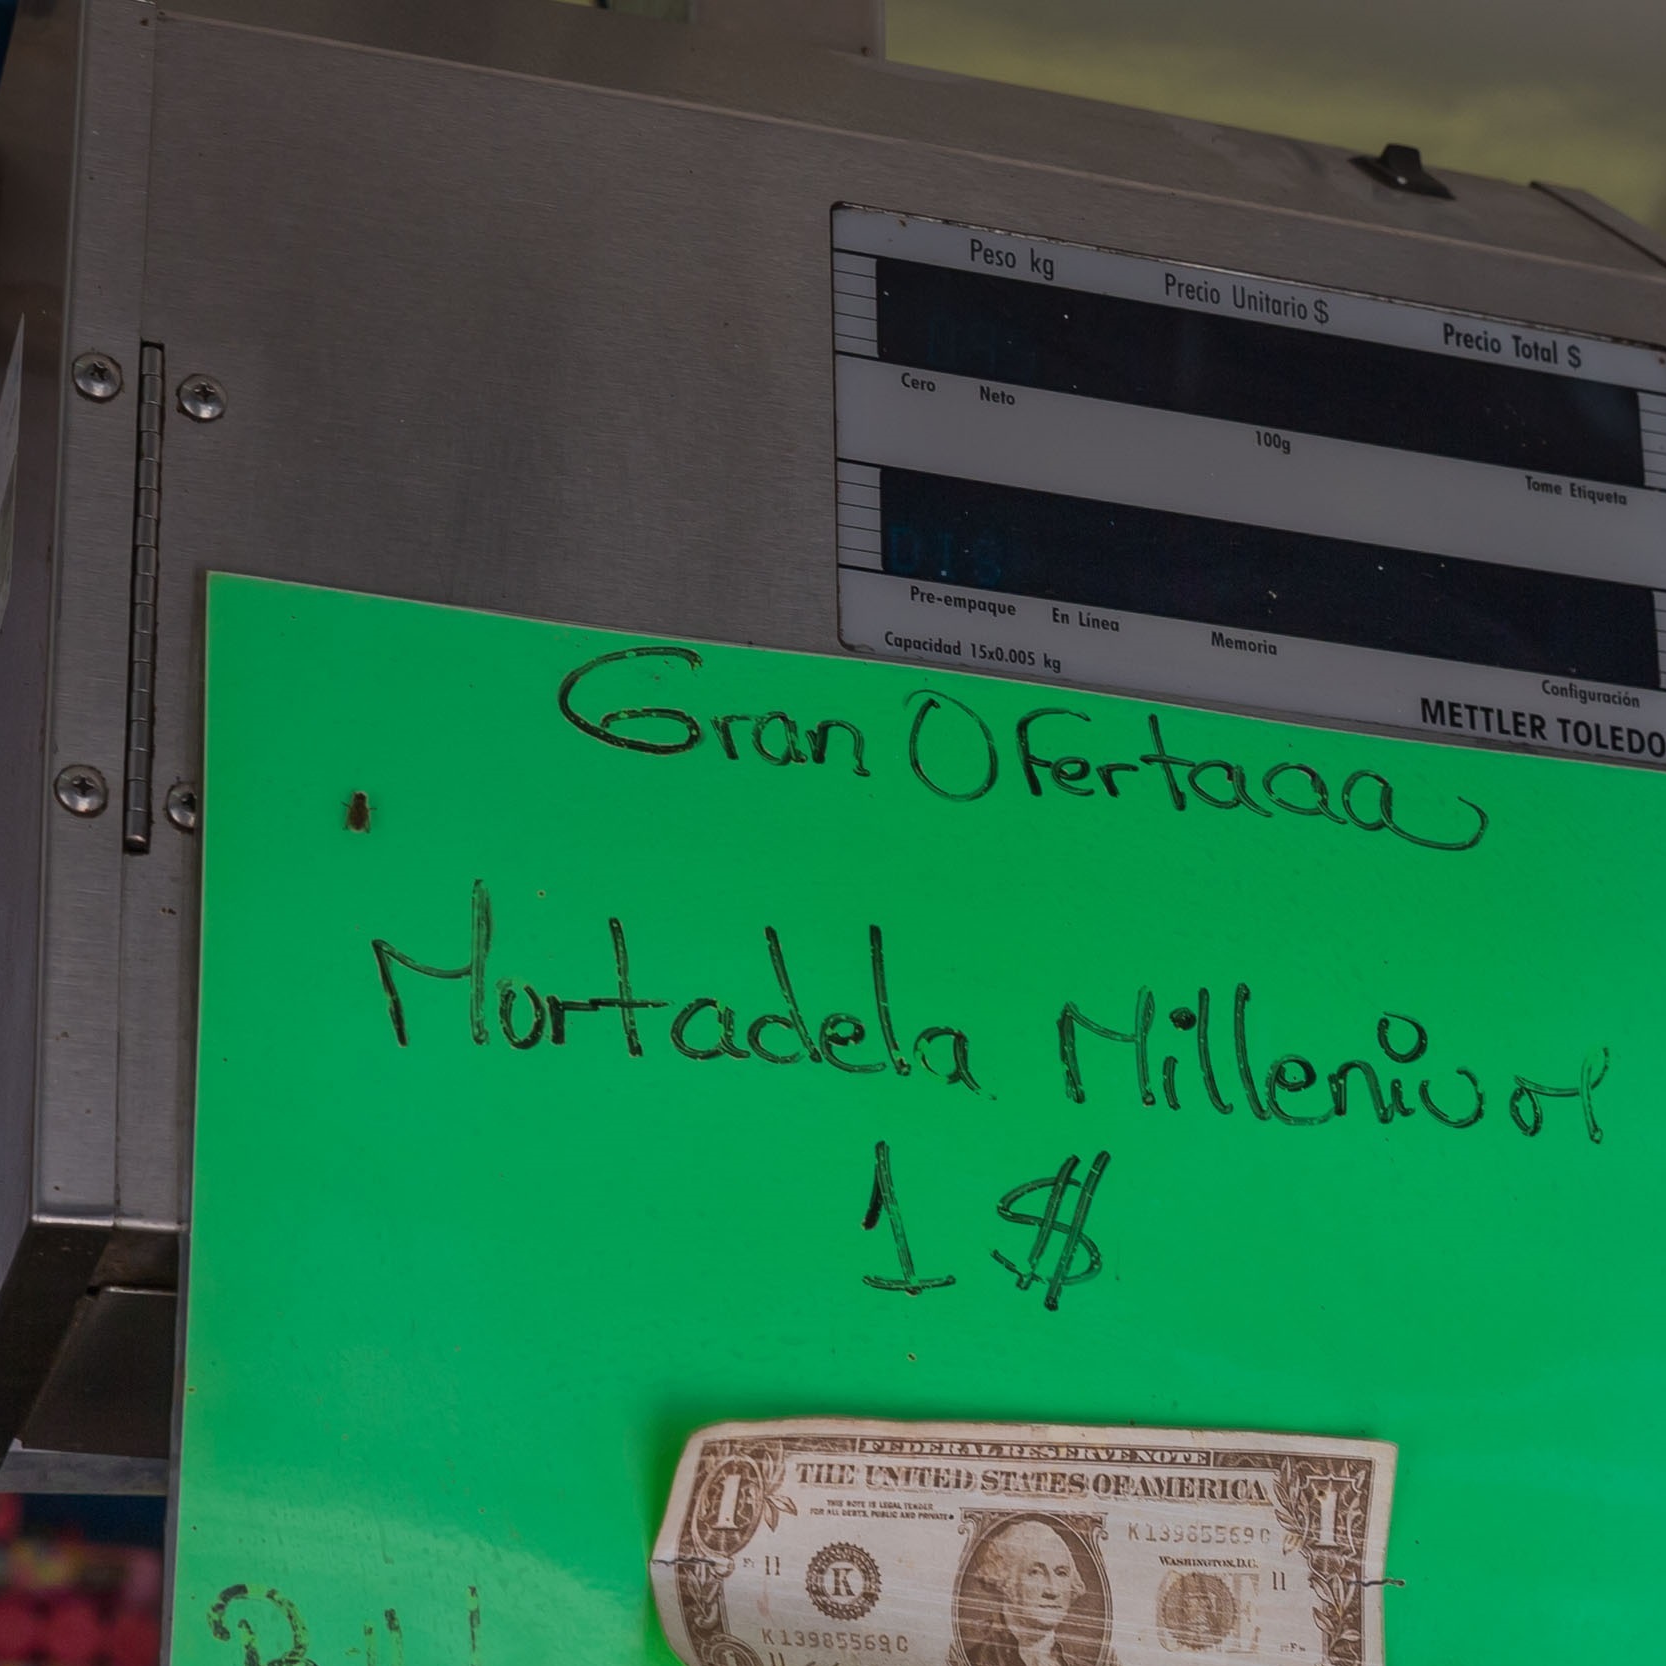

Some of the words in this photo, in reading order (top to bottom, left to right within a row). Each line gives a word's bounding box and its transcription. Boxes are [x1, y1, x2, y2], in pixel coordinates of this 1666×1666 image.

[969, 238, 1017, 269] Peso
[1030, 248, 1055, 281] kg
[1164, 272, 1221, 305] Precio
[1232, 284, 1308, 321] Unitario
[1313, 298, 1330, 325] $
[1442, 322, 1502, 354] Precio
[1513, 334, 1559, 365] Total
[1567, 345, 1582, 370] $
[900, 372, 936, 392] Cero
[979, 385, 1016, 405] Neto
[1255, 430, 1292, 454] 100g
[1524, 475, 1563, 497] Tome
[1569, 483, 1628, 506] Etiqueta
[910, 585, 1017, 618] Pre-empaque
[1052, 607, 1070, 625] En
[1078, 611, 1120, 632] Línea
[884, 631, 962, 657] Capacidad
[970, 643, 1036, 666] 15x0.005
[1043, 653, 1062, 674] kg
[1210, 630, 1278, 656] Memoria
[1541, 679, 1640, 709] Configuración
[558, 646, 871, 778] Gran
[1420, 697, 1548, 741] METTLER
[1556, 717, 1666, 758] TOLEDO
[372, 878, 985, 1099] Mortadela
[861, 1140, 957, 1297] 1
[989, 1149, 1112, 1312] $
[861, 1438, 1002, 1460] FEDERAL
[1002, 1442, 1135, 1464] RESERVE
[1134, 1448, 1209, 1466] NOTE
[794, 1462, 856, 1486] THE
[865, 1464, 975, 1491] UNITED
[980, 1469, 1086, 1495] STATES
[1092, 1472, 1133, 1497] OF
[1134, 1475, 1268, 1502] AMERICA
[832, 1567, 856, 1597] K
